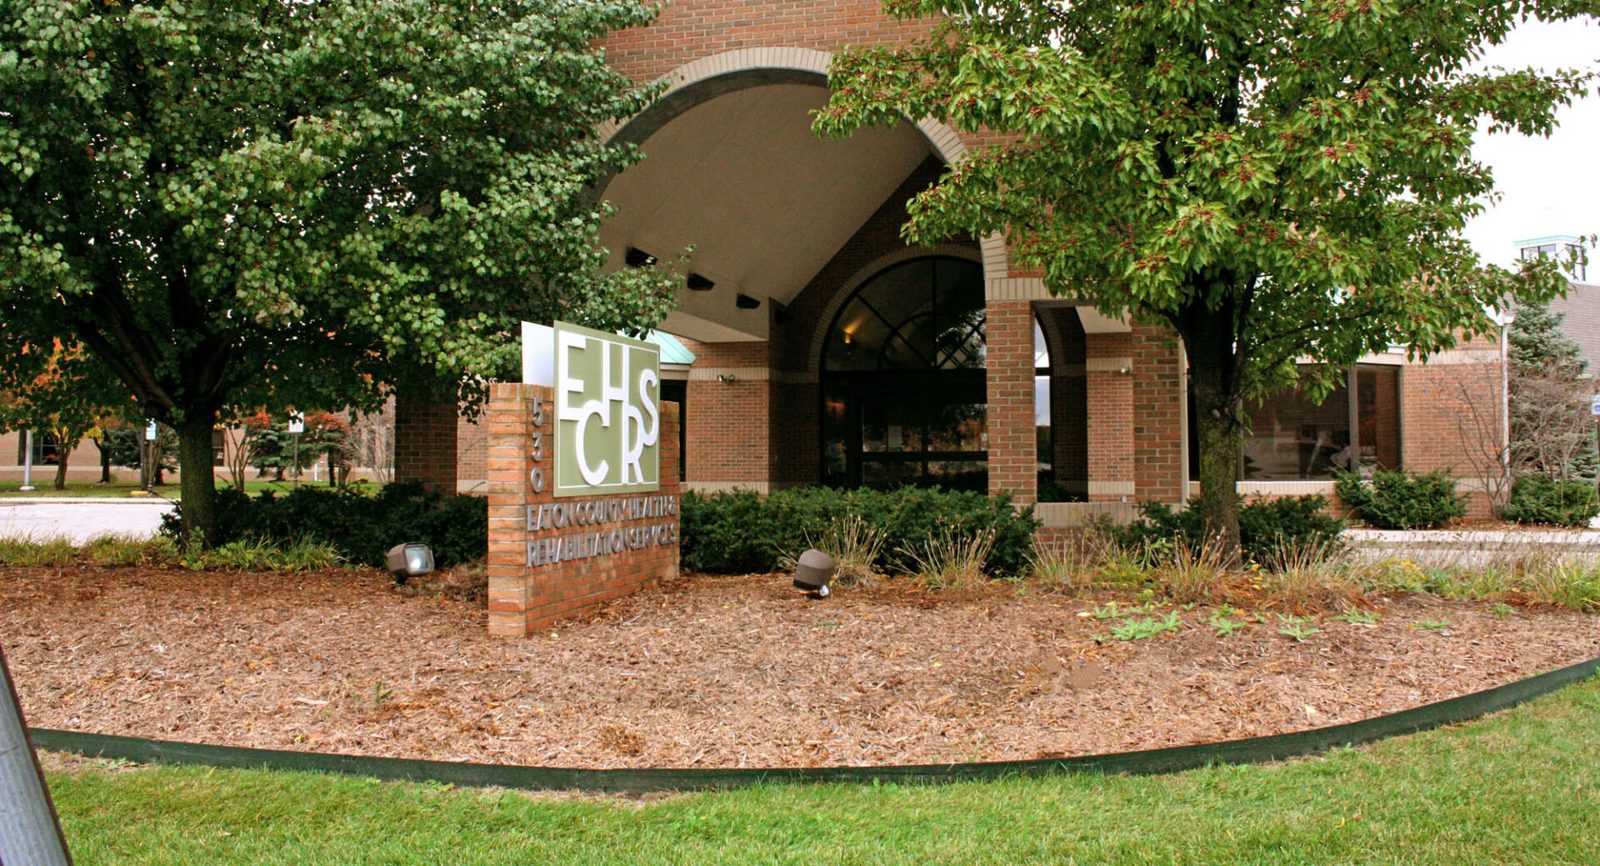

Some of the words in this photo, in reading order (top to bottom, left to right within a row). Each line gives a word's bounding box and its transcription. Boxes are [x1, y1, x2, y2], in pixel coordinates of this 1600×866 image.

[530, 397, 544, 494] 530
[527, 501, 574, 531] EATON
[575, 499, 627, 527] COUNTY
[628, 495, 668, 520] HEALTH
[526, 527, 628, 568] REHABILITATION
[629, 523, 677, 551] SERVICES
